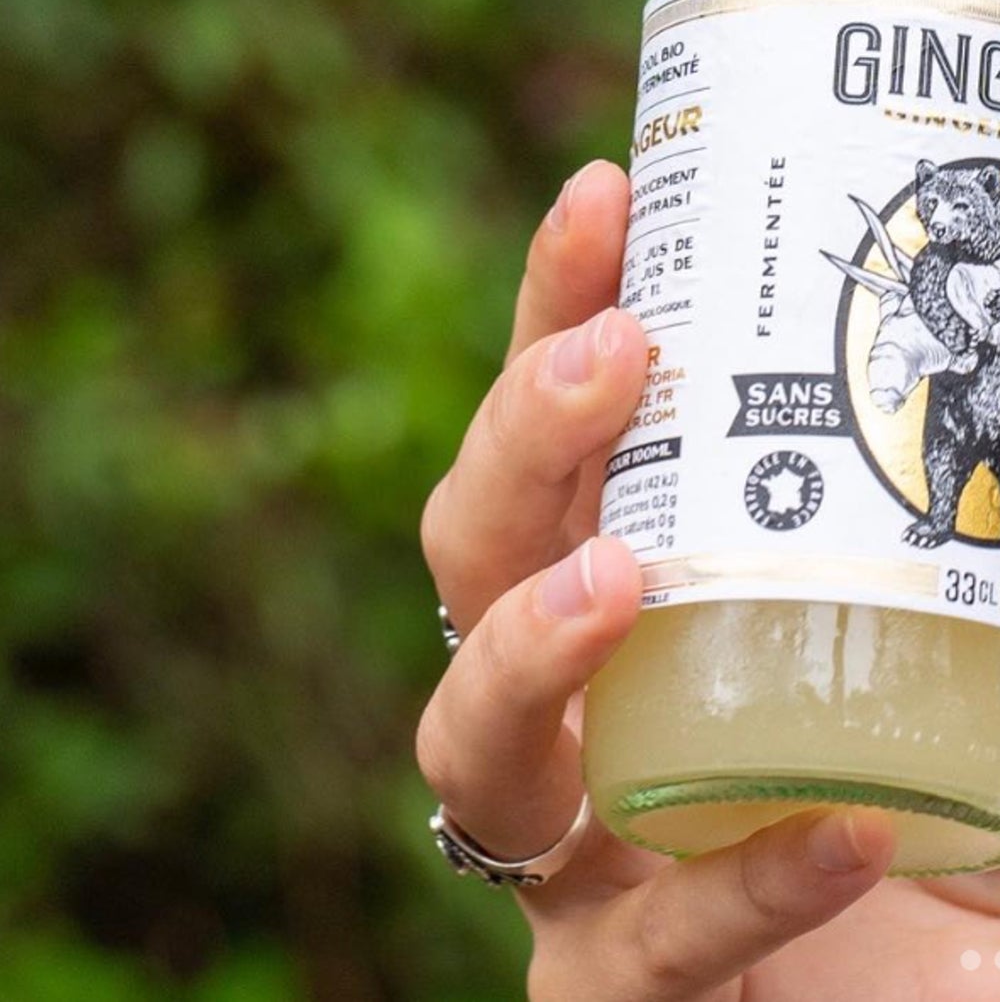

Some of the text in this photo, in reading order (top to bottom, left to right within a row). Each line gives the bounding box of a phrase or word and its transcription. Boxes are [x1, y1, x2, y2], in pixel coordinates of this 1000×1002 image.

[661, 41, 685, 62] BIO
[648, 194, 683, 215] FRAIS
[644, 242, 669, 262] JUS
[674, 236, 694, 253] DE
[757, 157, 786, 338] FERMENTÉE
[641, 255, 694, 282] JUS DE
[656, 388, 674, 405] FR
[746, 382, 833, 406] SANS
[745, 407, 841, 428] SUCRES
[668, 494, 677, 509] g
[657, 513, 666, 528] 0
[667, 514, 676, 529] g
[656, 533, 675, 550] 0 g
